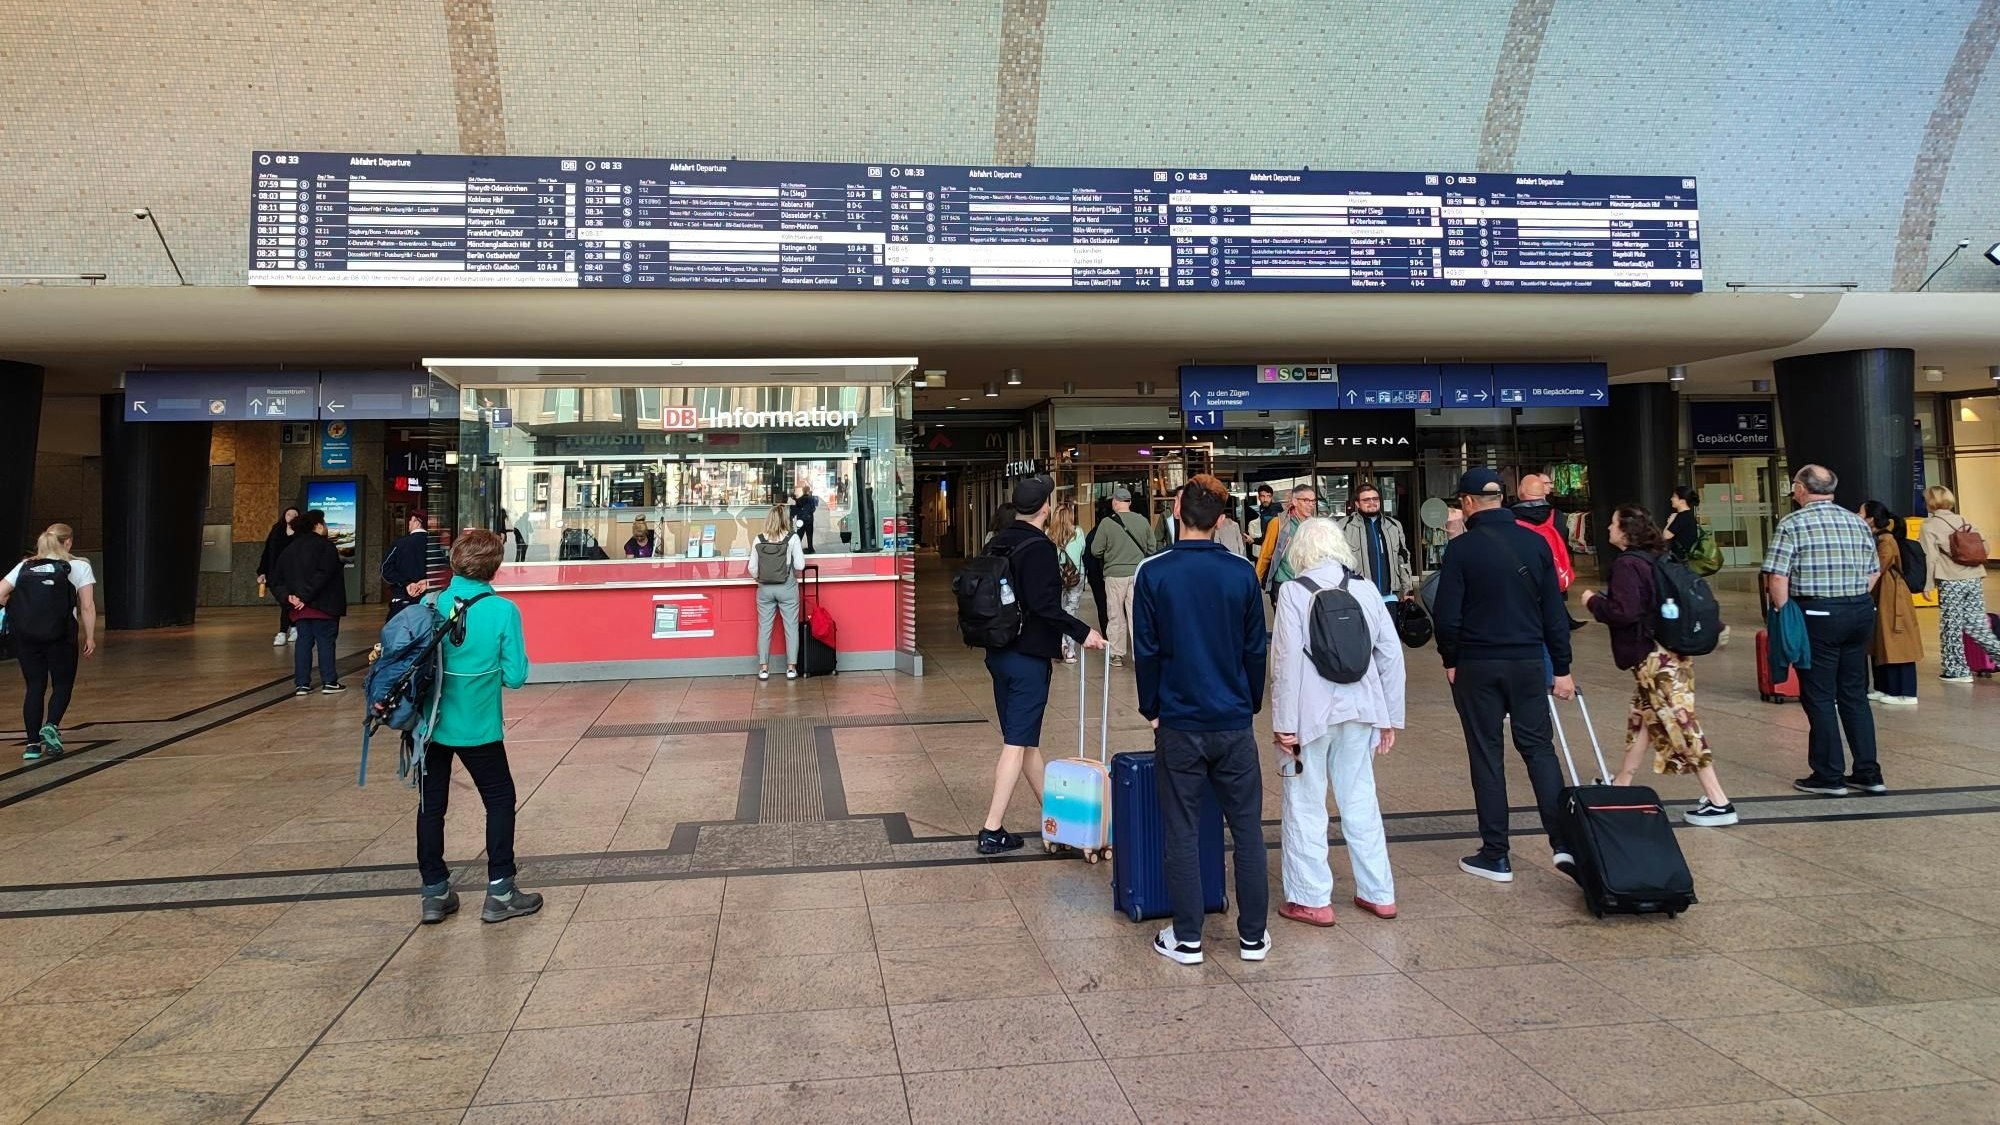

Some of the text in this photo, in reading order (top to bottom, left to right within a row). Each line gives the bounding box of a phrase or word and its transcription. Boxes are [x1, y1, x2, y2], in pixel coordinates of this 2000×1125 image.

[379, 158, 411, 167] Departure
[697, 164, 727, 172] Departure
[994, 171, 1022, 179] Departure
[1273, 174, 1300, 182] Departure
[1538, 178, 1564, 187] Departure
[1279, 368, 1289, 380] S
[1230, 389, 1249, 398] Zügen
[664, 406, 858, 428] DB Information
[1324, 437, 1409, 445] ETERNA
[1697, 434, 1768, 445] GepäckCenter
[1006, 459, 1035, 476] ETERNA
